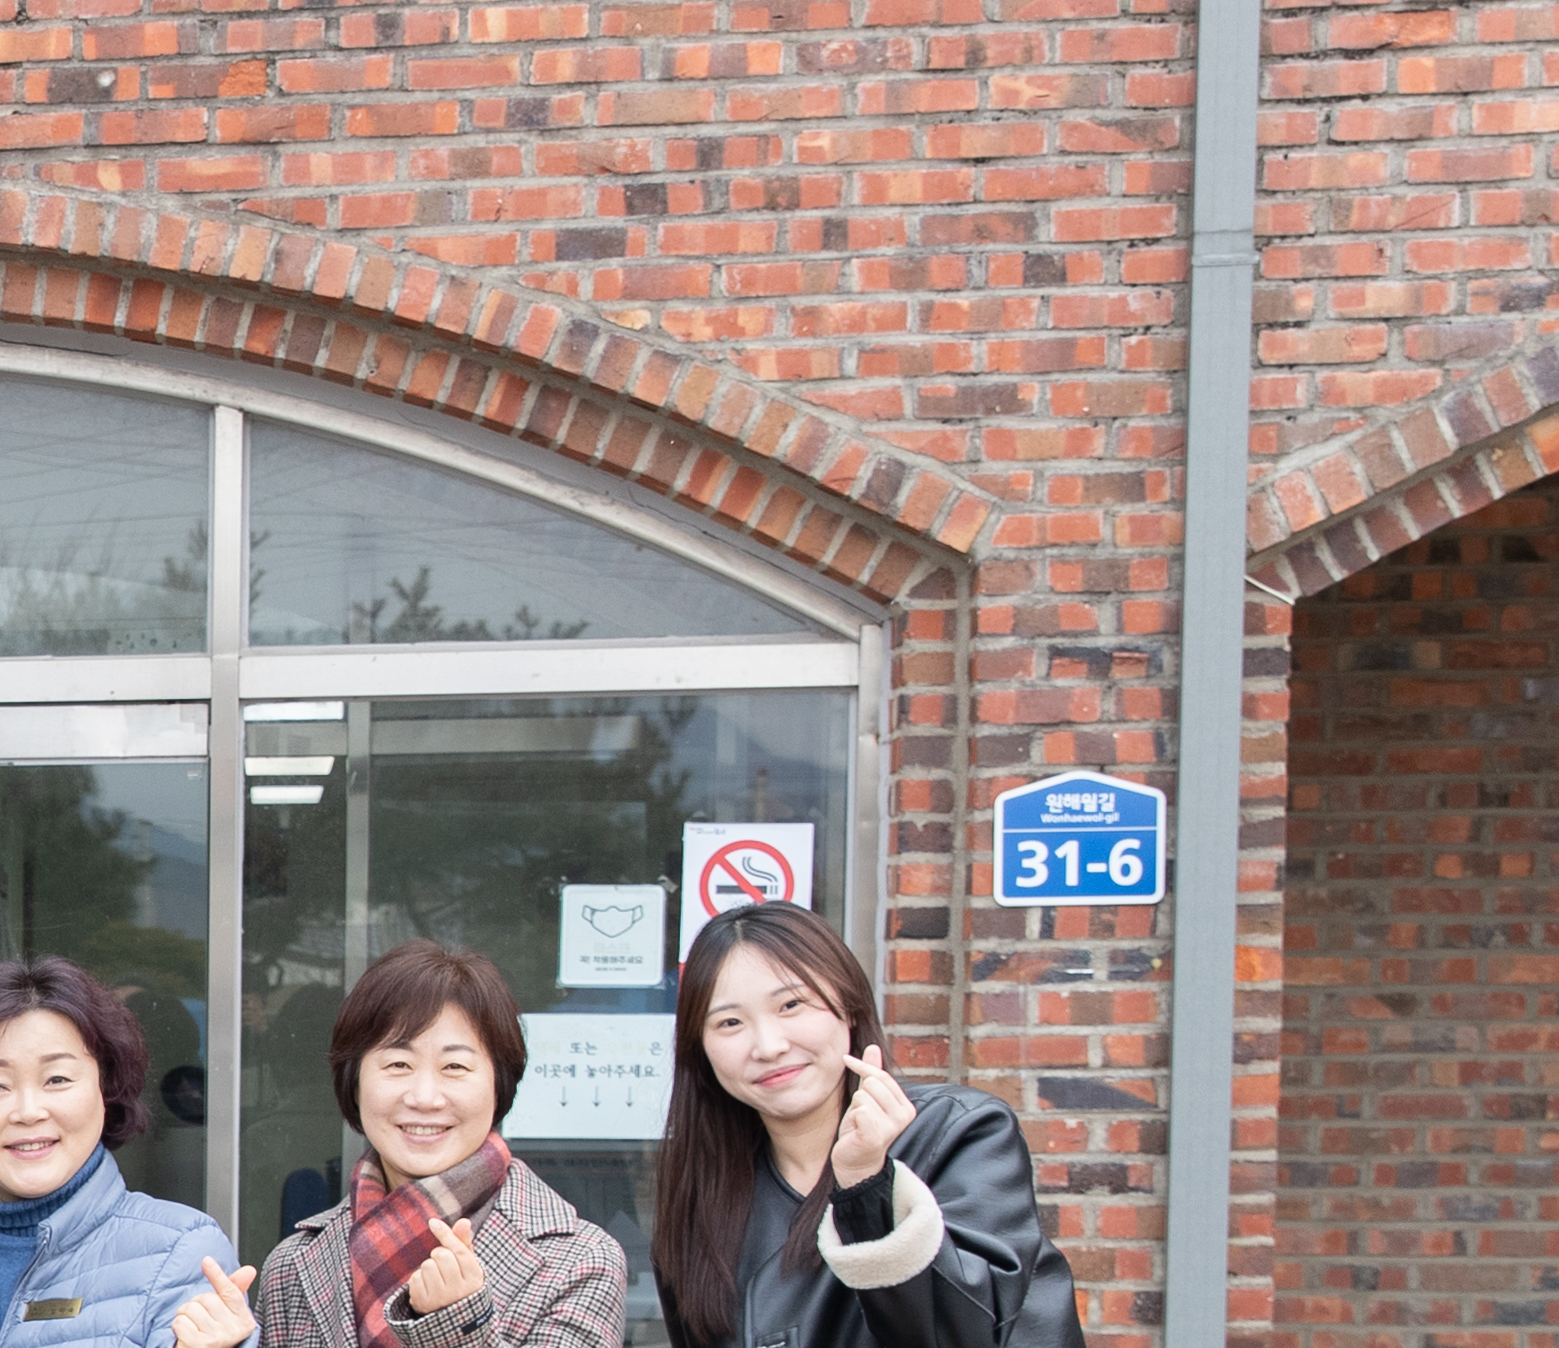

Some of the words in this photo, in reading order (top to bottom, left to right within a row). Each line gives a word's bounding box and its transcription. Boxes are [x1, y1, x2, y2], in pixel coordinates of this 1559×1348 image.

[1045, 792, 1116, 813] 원해월길
[1040, 812, 1120, 825] Wonhaewol-gil
[1015, 838, 1144, 888] 31-6
[569, 1041, 598, 1056] 또는
[534, 1063, 577, 1078] 이곳에
[585, 1063, 661, 1079] 놓아주세요.
